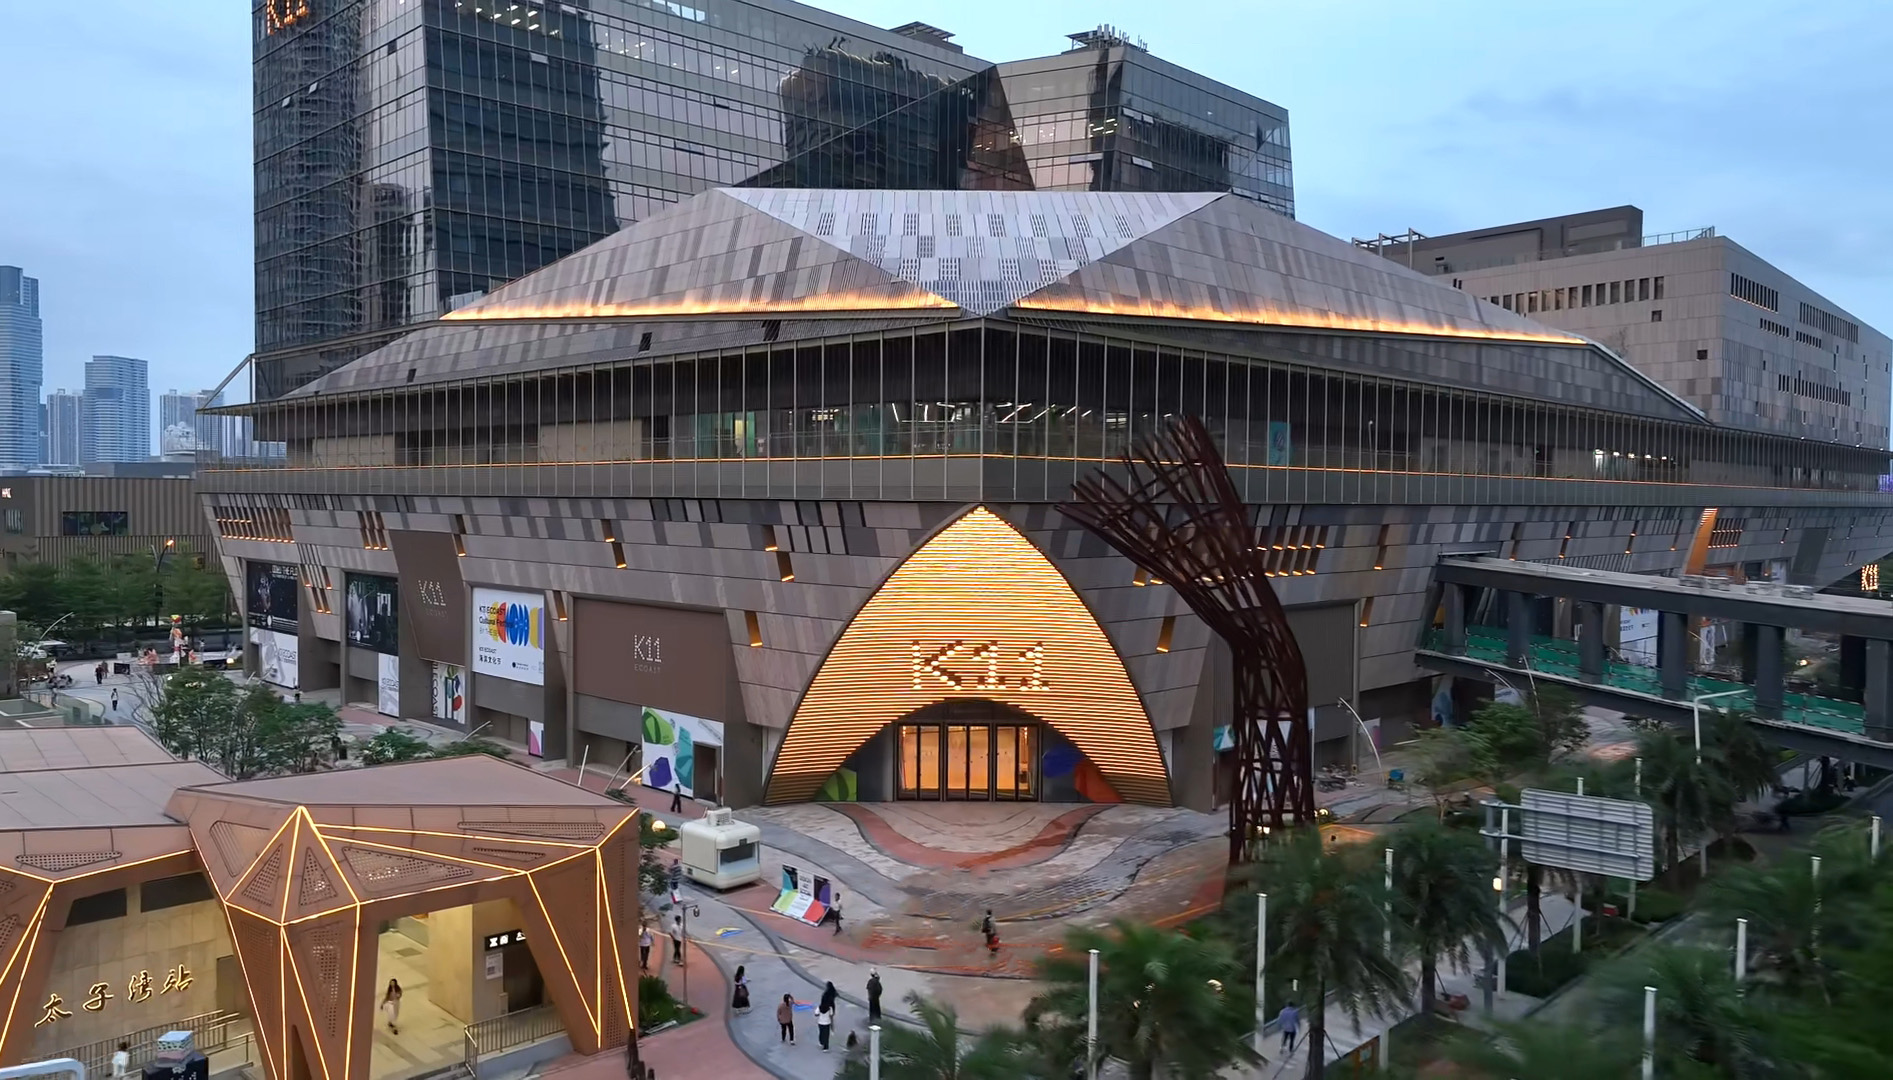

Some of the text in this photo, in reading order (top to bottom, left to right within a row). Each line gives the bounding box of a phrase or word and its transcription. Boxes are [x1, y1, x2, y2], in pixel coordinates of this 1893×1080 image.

[1861, 564, 1878, 590] K11
[418, 580, 446, 606] K11
[634, 635, 662, 662] K11
[912, 640, 1050, 691] K11
[34, 964, 194, 1028] 太子湾站
